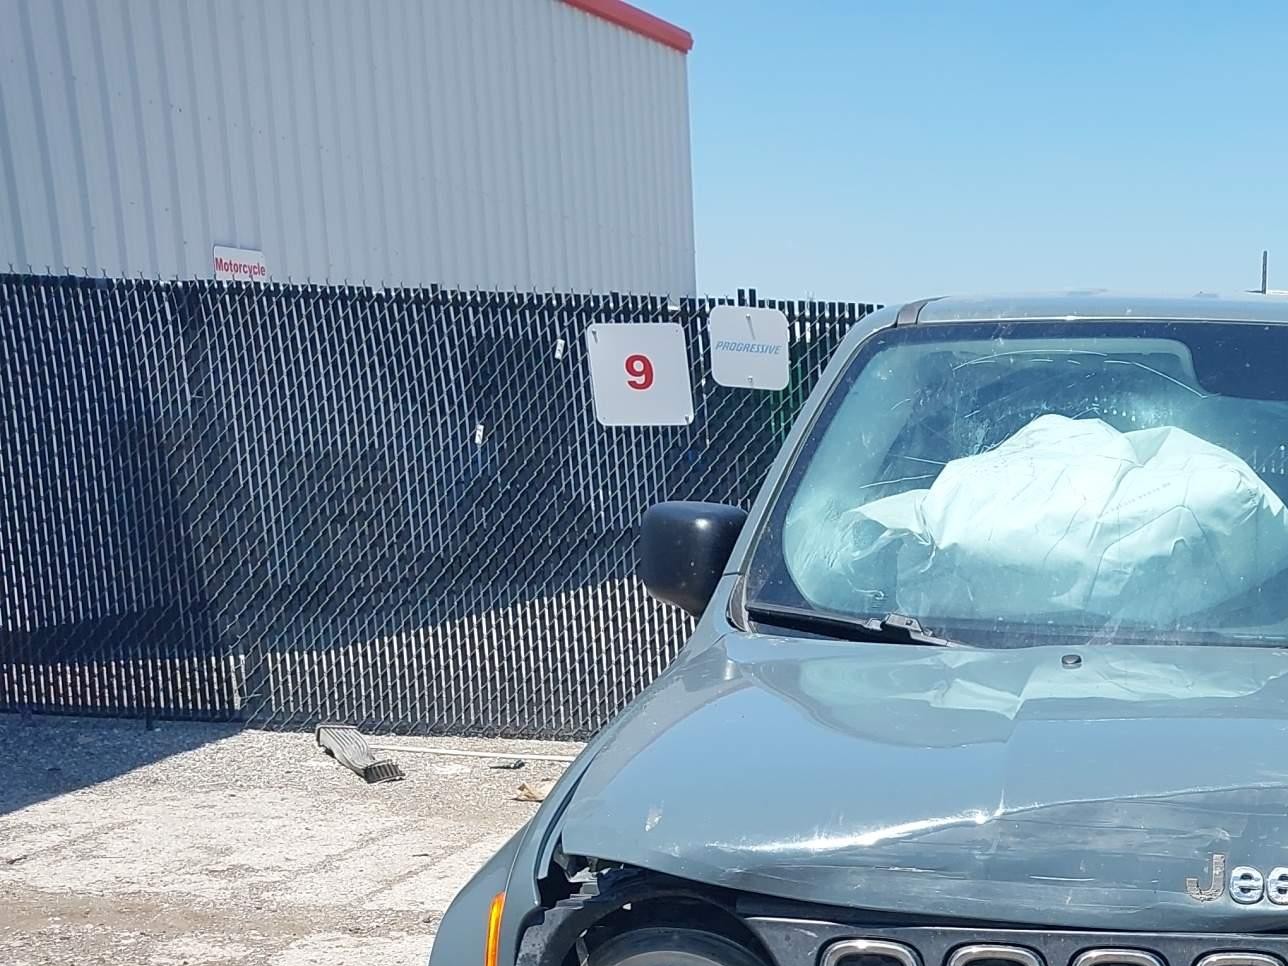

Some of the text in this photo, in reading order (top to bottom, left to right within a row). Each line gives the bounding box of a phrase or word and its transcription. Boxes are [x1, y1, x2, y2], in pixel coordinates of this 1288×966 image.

[215, 257, 266, 277] Motorcycle
[715, 341, 783, 355] PROGRESSIVE
[625, 354, 654, 391] 9
